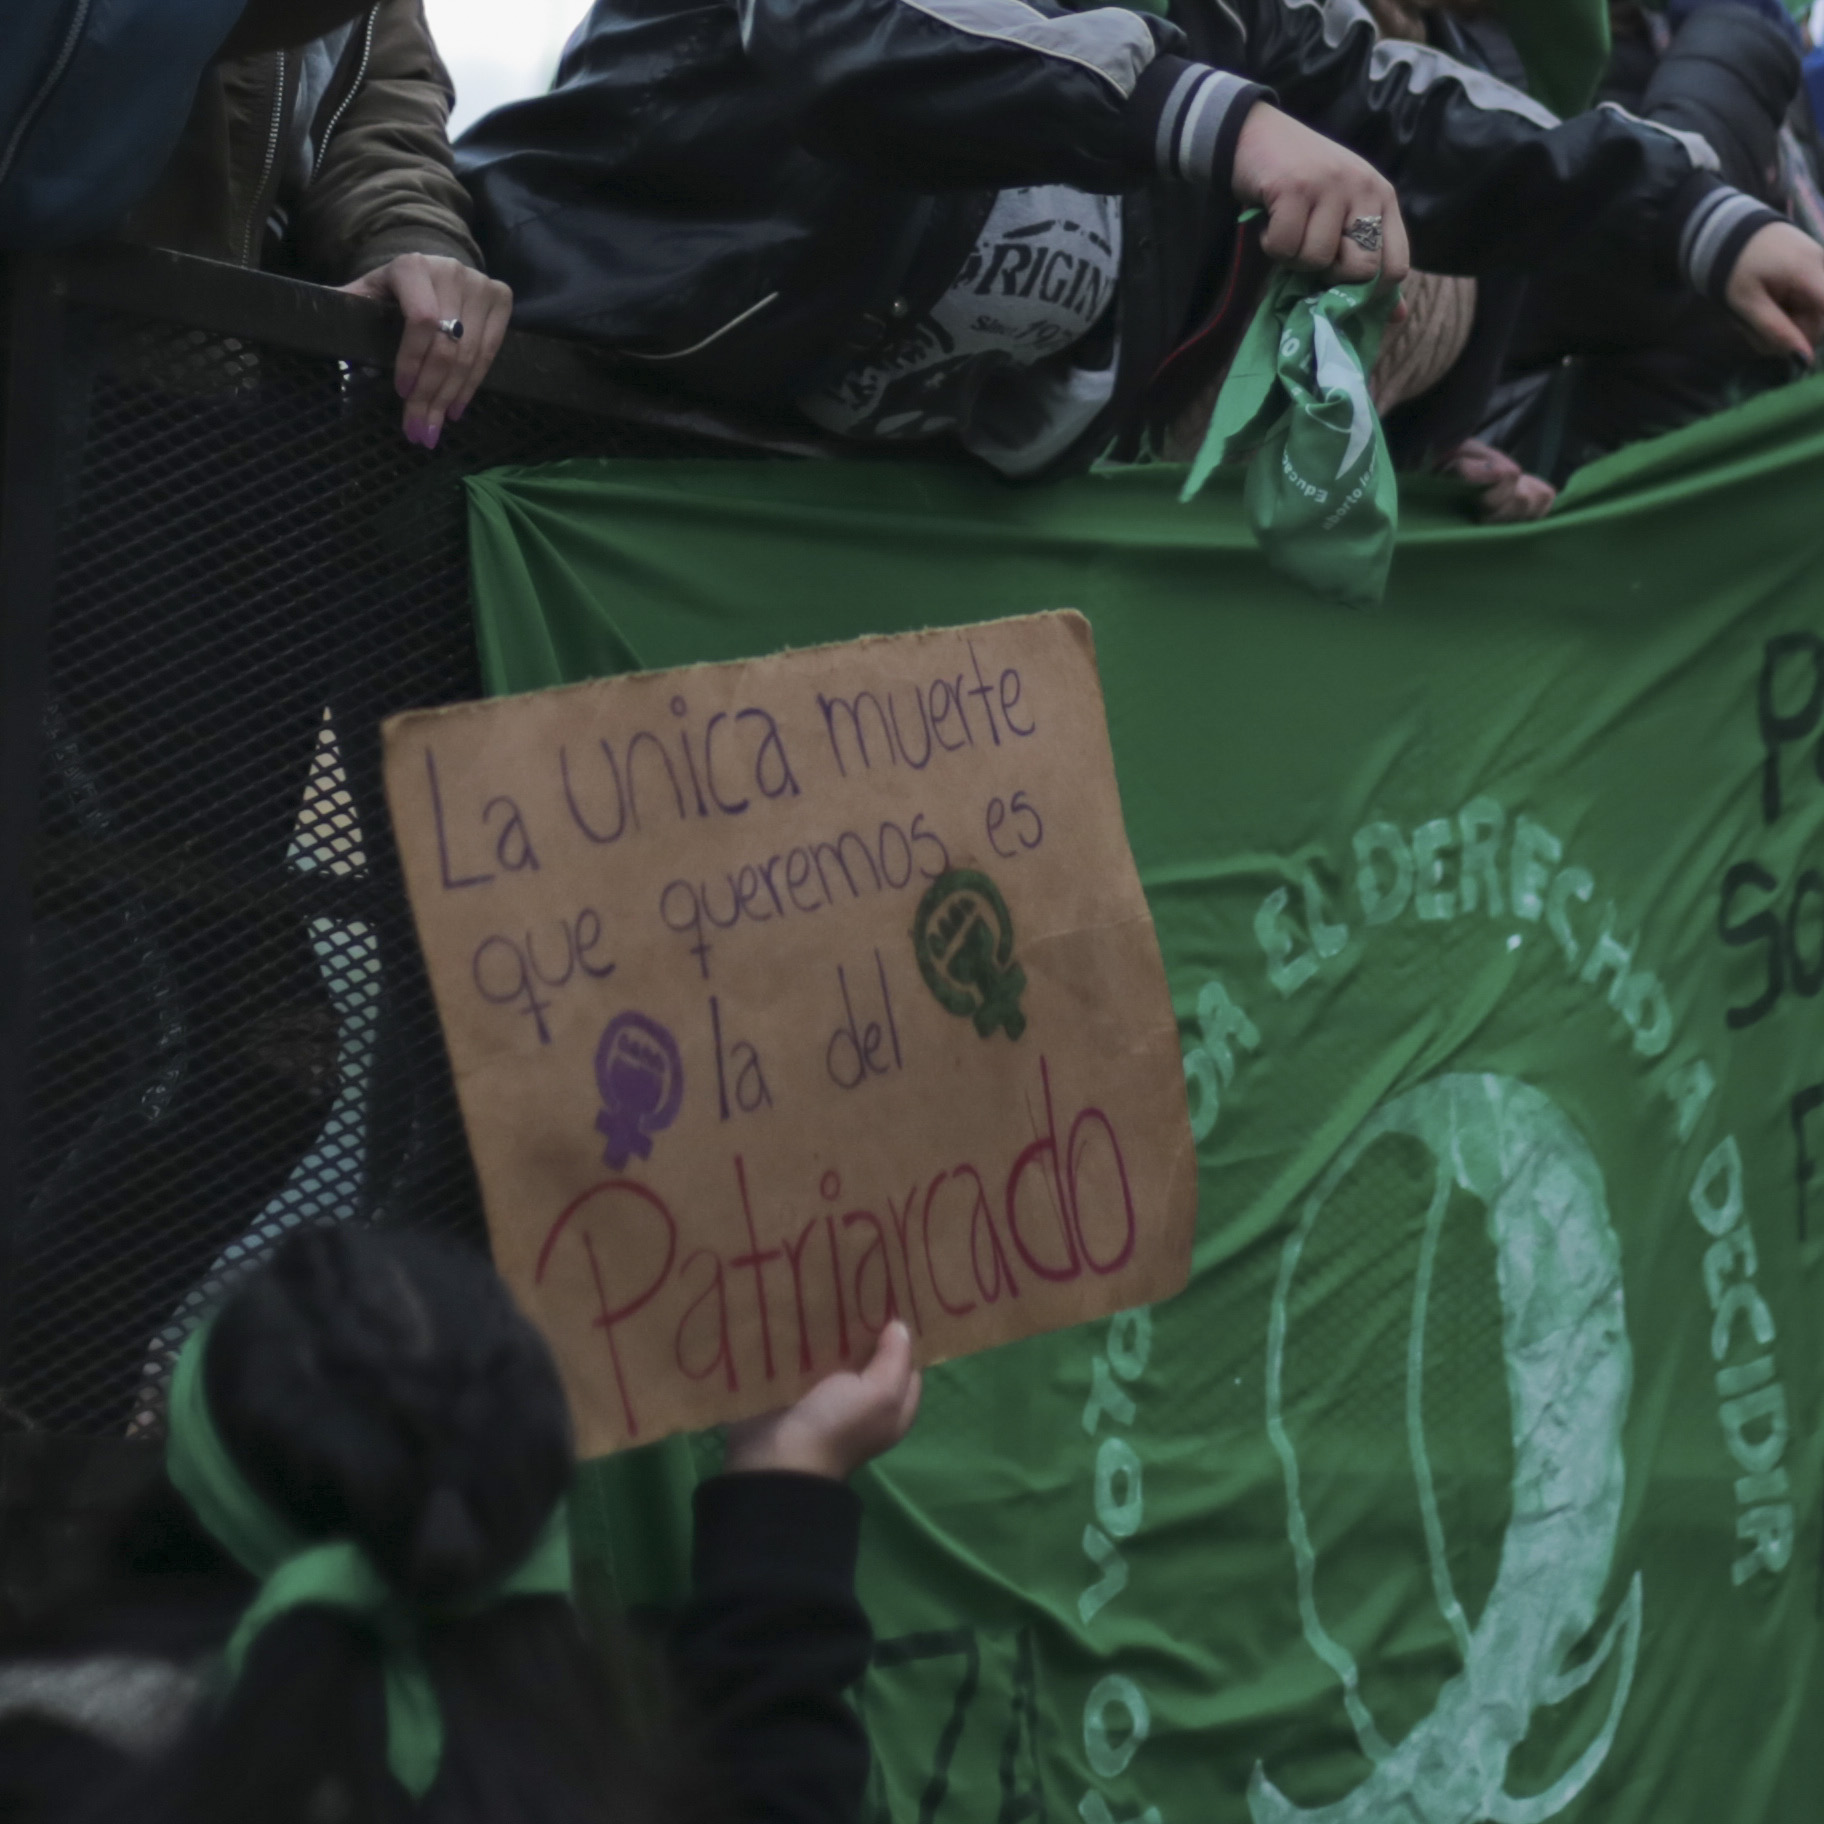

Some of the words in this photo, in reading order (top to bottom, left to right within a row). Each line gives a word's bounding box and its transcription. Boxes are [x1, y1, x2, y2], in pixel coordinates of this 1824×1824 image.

[425, 746, 540, 889] La
[817, 641, 1037, 779] muerte
[472, 907, 617, 1046] que
[659, 812, 950, 981] queremos
[985, 790, 1044, 859] es
[709, 995, 774, 1122] la
[825, 949, 904, 1091] del
[535, 1054, 1138, 1439] Patriarcado
[1351, 795, 1674, 1057] DERECHO
[1689, 1133, 1796, 1587] DECIDIR
